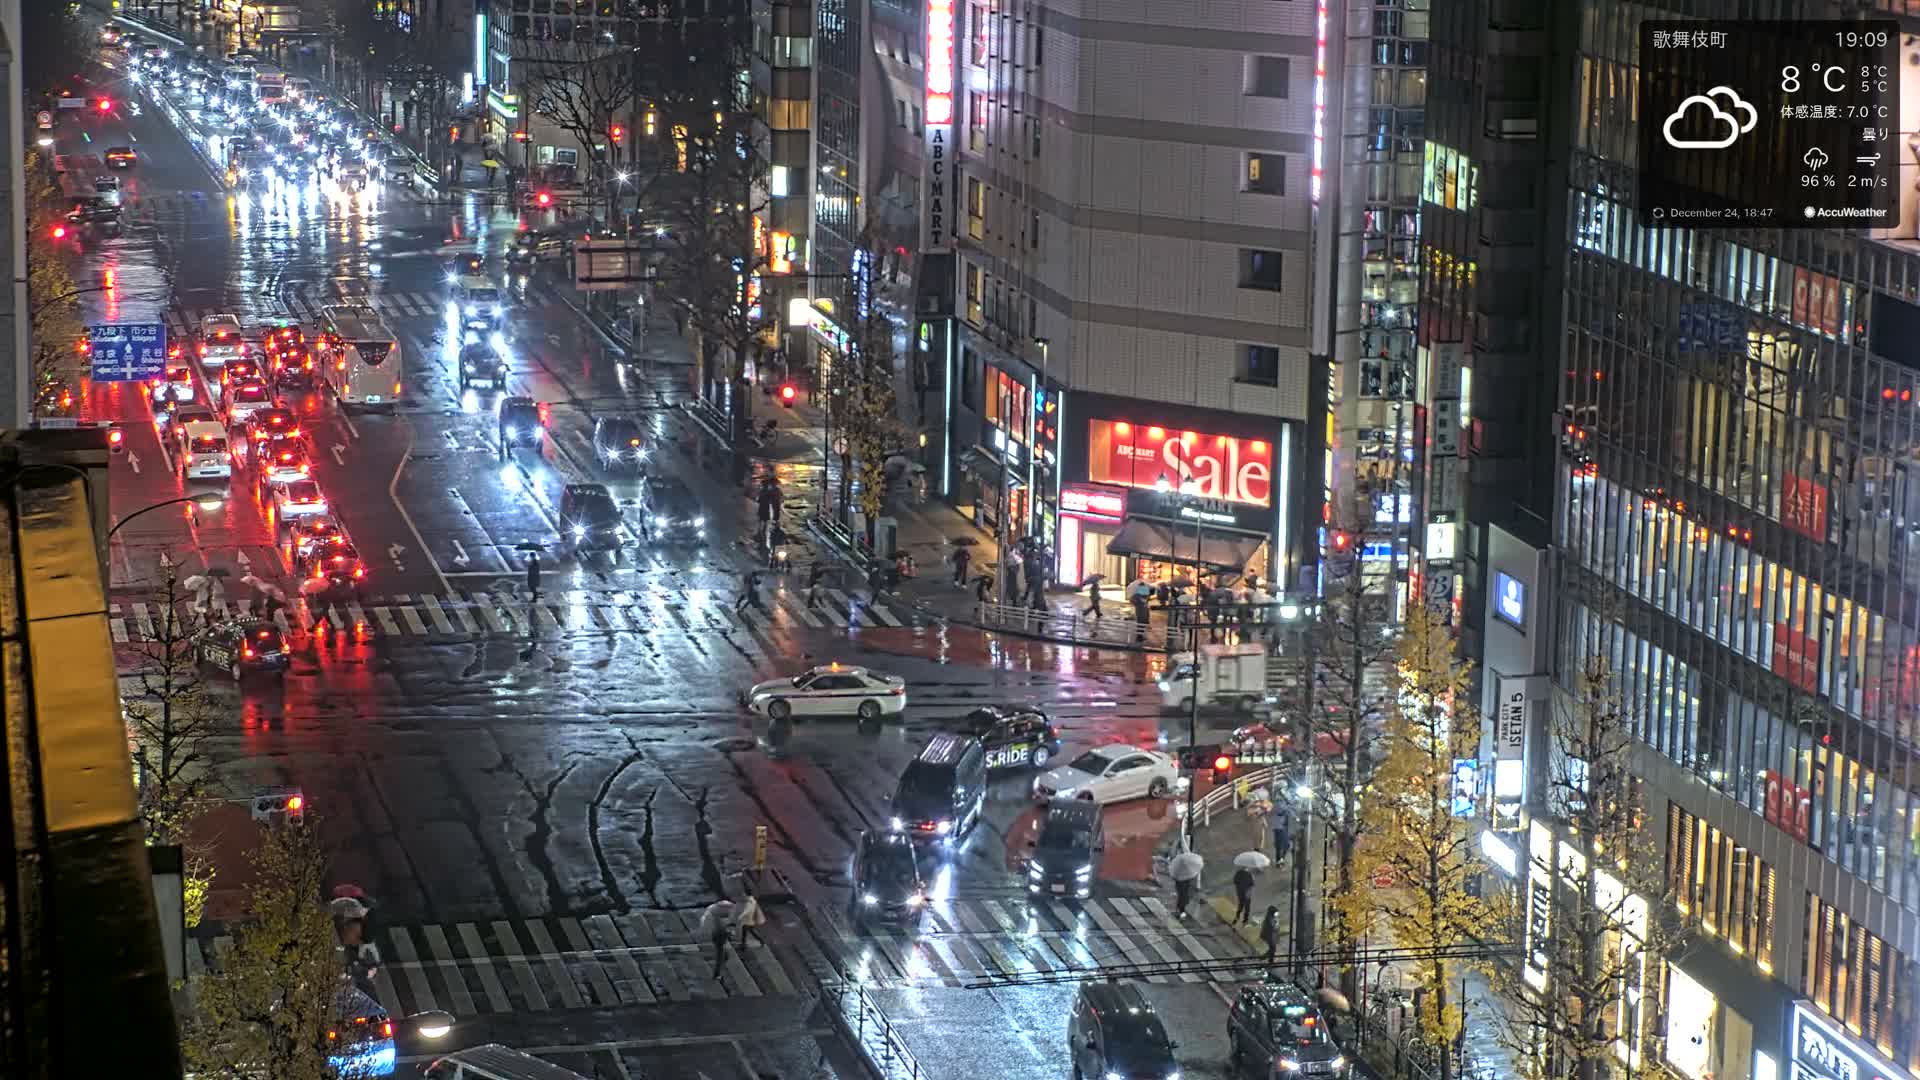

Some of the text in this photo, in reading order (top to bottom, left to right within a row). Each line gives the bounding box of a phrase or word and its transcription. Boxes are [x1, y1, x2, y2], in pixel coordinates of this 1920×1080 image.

[1162, 436, 1270, 507] Sale
[1509, 692, 1523, 747] ISETAN 5
[986, 748, 1028, 768] S.RIDE
